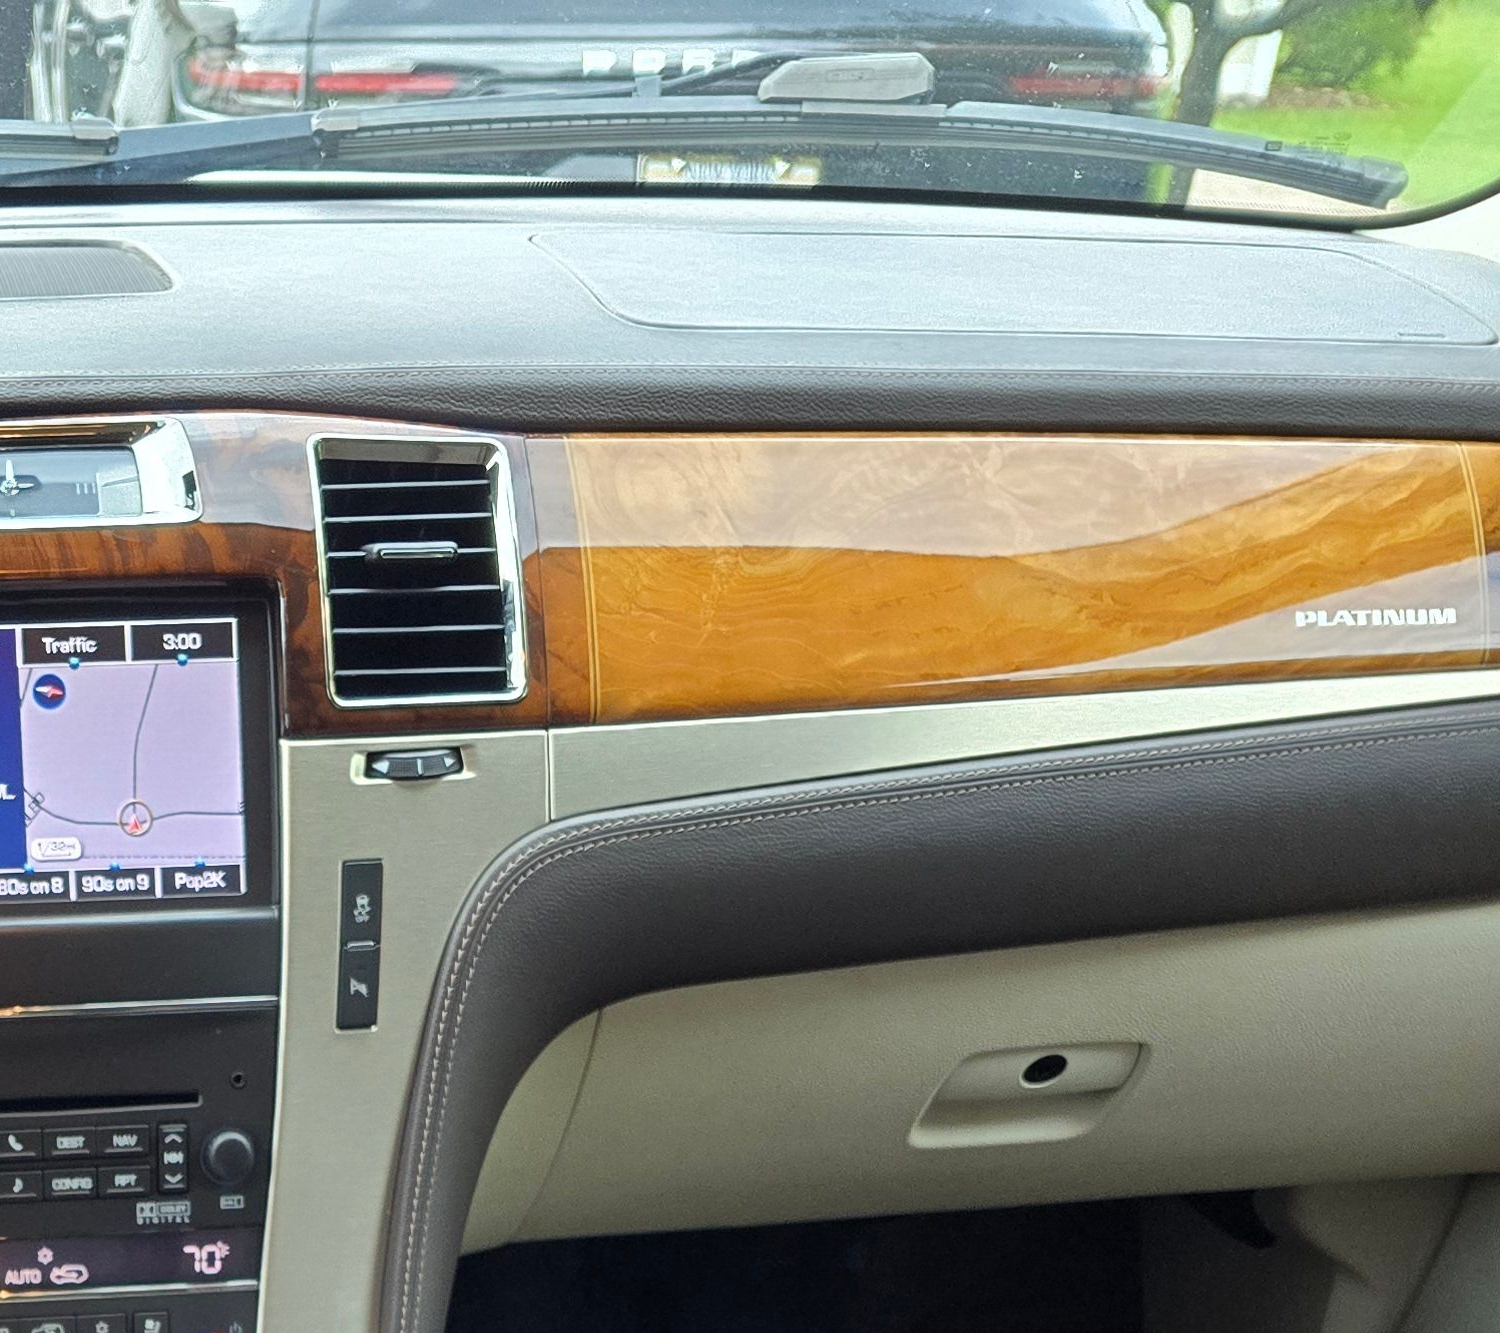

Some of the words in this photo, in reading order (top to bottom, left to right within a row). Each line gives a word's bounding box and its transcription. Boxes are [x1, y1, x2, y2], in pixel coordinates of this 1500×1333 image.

[1295, 607, 1457, 627] PLATINUM
[41, 636, 98, 654] Traffic
[162, 633, 202, 650] 3:00
[30, 879, 50, 895] on
[51, 877, 64, 894] 8
[81, 876, 114, 893] 90s
[116, 876, 136, 892] on
[136, 873, 150, 891] 9
[174, 870, 227, 892] Pop2K
[112, 1134, 138, 1147] NAV
[5, 1269, 41, 1286] AUTO
